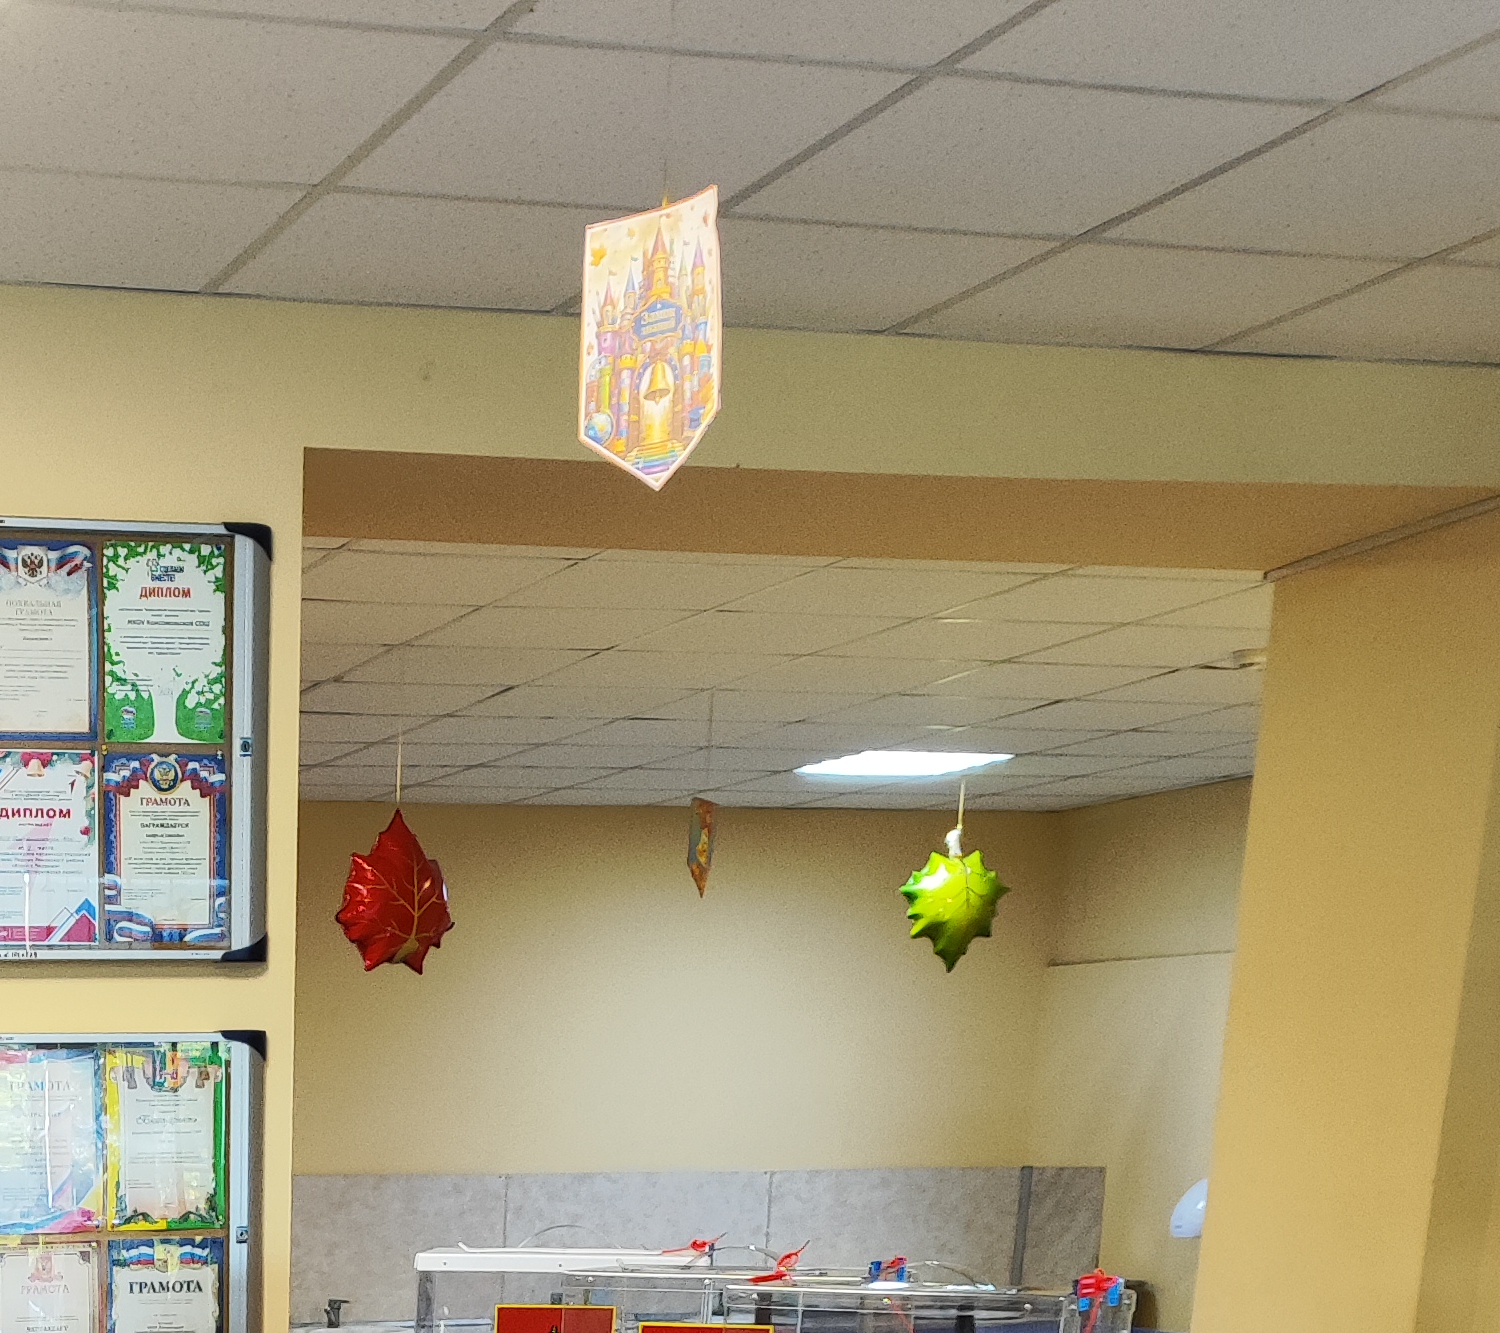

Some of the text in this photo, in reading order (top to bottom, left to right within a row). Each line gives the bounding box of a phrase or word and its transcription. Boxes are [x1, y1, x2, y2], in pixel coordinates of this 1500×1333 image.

[139, 586, 191, 599] ДИПЛОМ
[140, 797, 190, 807] ГРАМОТА
[20, 1284, 70, 1295] ГРАМОТА
[128, 1279, 203, 1294] ГРАМОТА
